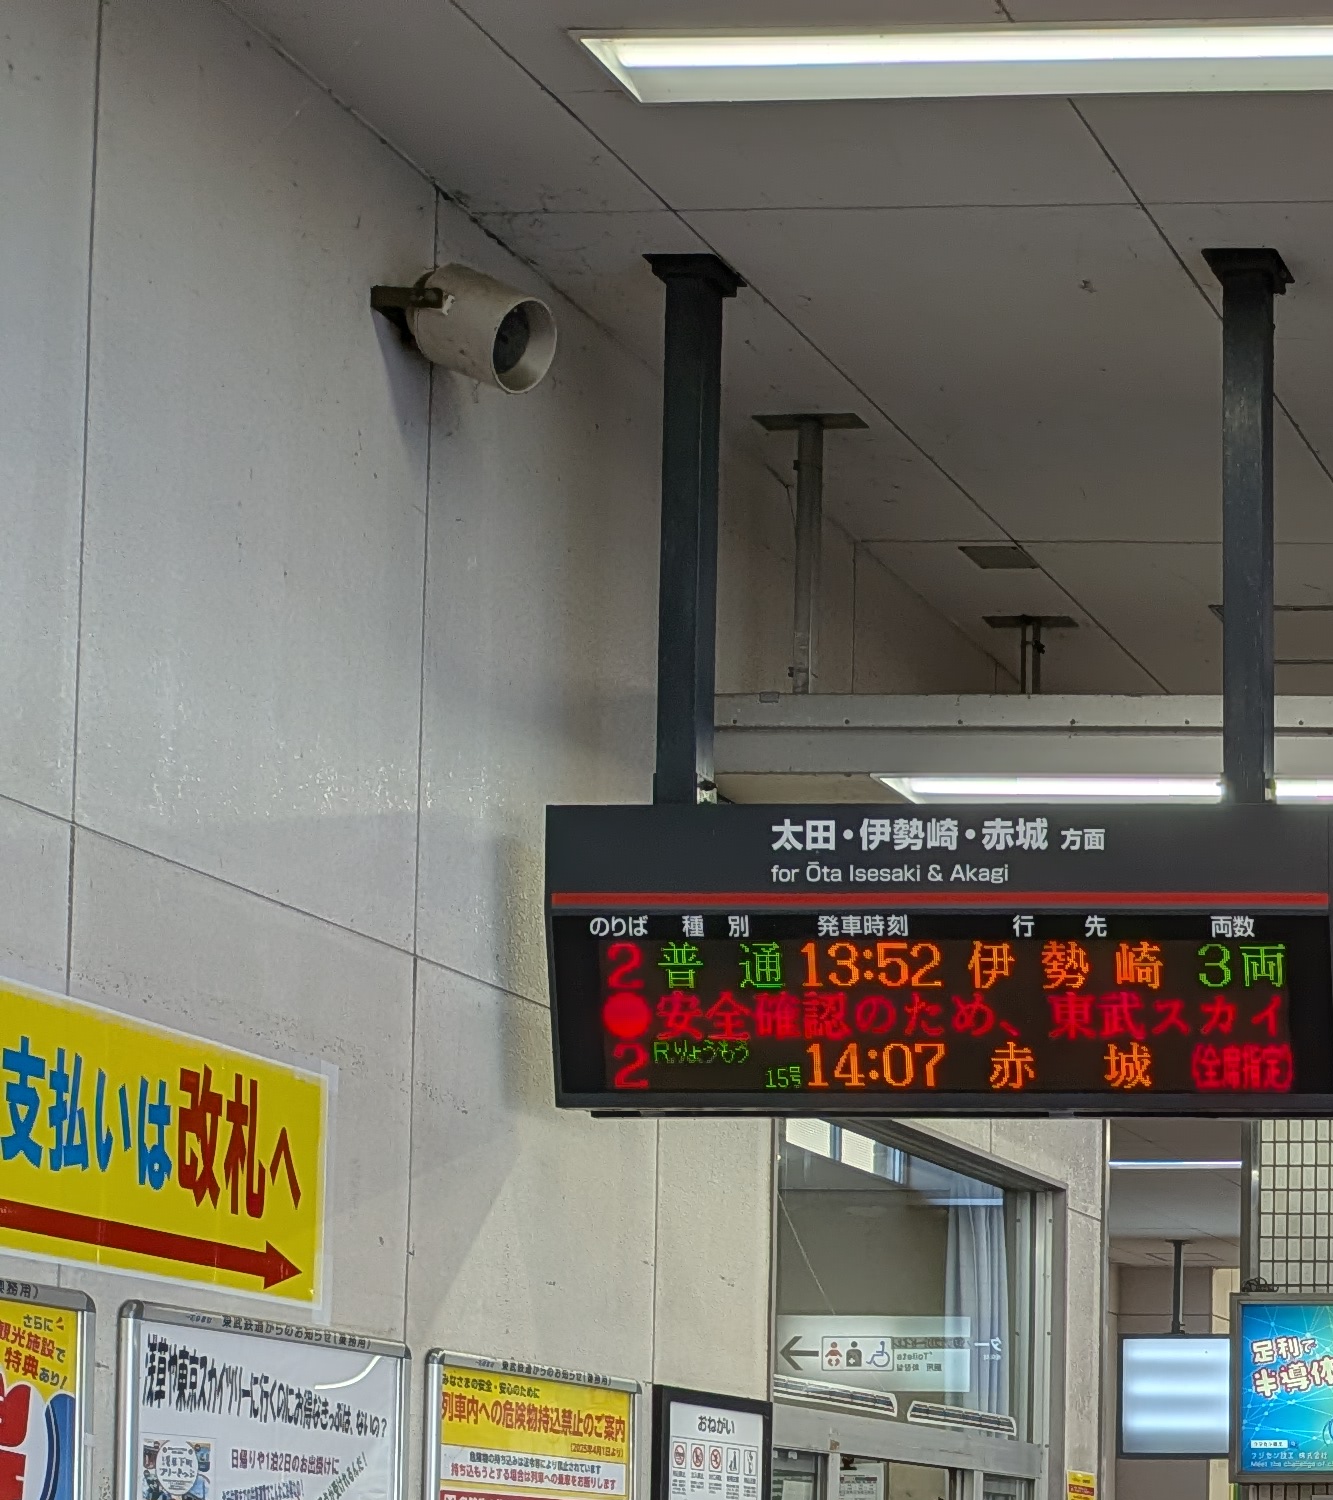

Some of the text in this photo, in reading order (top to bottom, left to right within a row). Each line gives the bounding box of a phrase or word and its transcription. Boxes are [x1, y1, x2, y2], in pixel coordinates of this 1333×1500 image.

[771, 817, 1106, 851] 太田・伊勢崎・赤城 方面
[771, 859, 1009, 886] for Ōta Isesaki & Akagi
[590, 916, 649, 938] のりば
[817, 914, 909, 938] 発車時刻
[1210, 914, 1256, 938] 両数
[606, 942, 643, 990] 2
[801, 943, 942, 989] 13:52
[1199, 942, 1287, 990] 3両
[613, 1042, 651, 1090] 2
[806, 1042, 946, 1089] 14:07
[1, 1035, 301, 1219] 支払いは改札へ
[23, 1313, 54, 1332] さらに
[696, 1413, 736, 1436] おねがい
